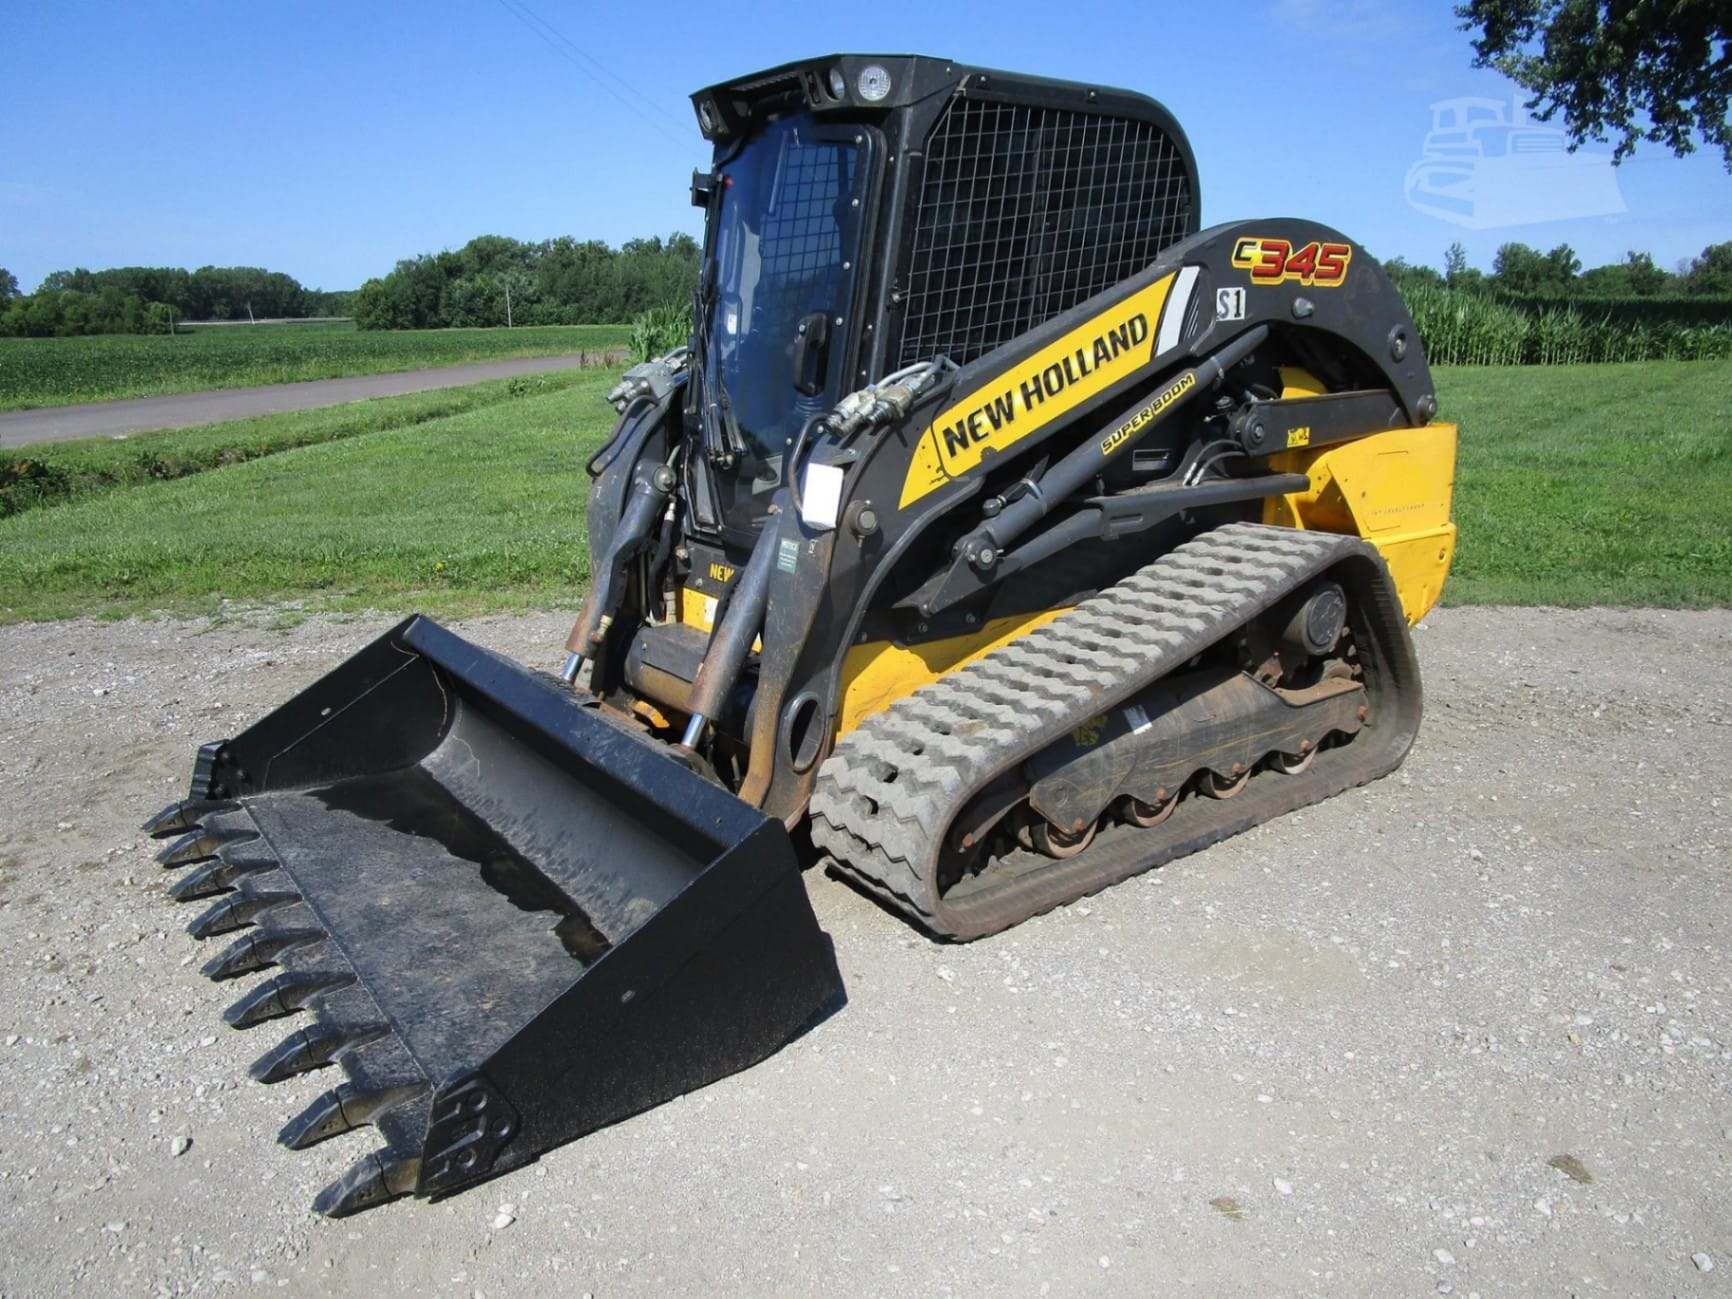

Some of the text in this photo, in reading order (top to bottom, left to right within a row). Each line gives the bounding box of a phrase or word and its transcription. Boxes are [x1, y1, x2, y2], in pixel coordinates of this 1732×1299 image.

[942, 313, 1148, 458] NEW HOLLAND
[1101, 373, 1195, 455] SUPER BOOM
[709, 562, 735, 582] NEW
